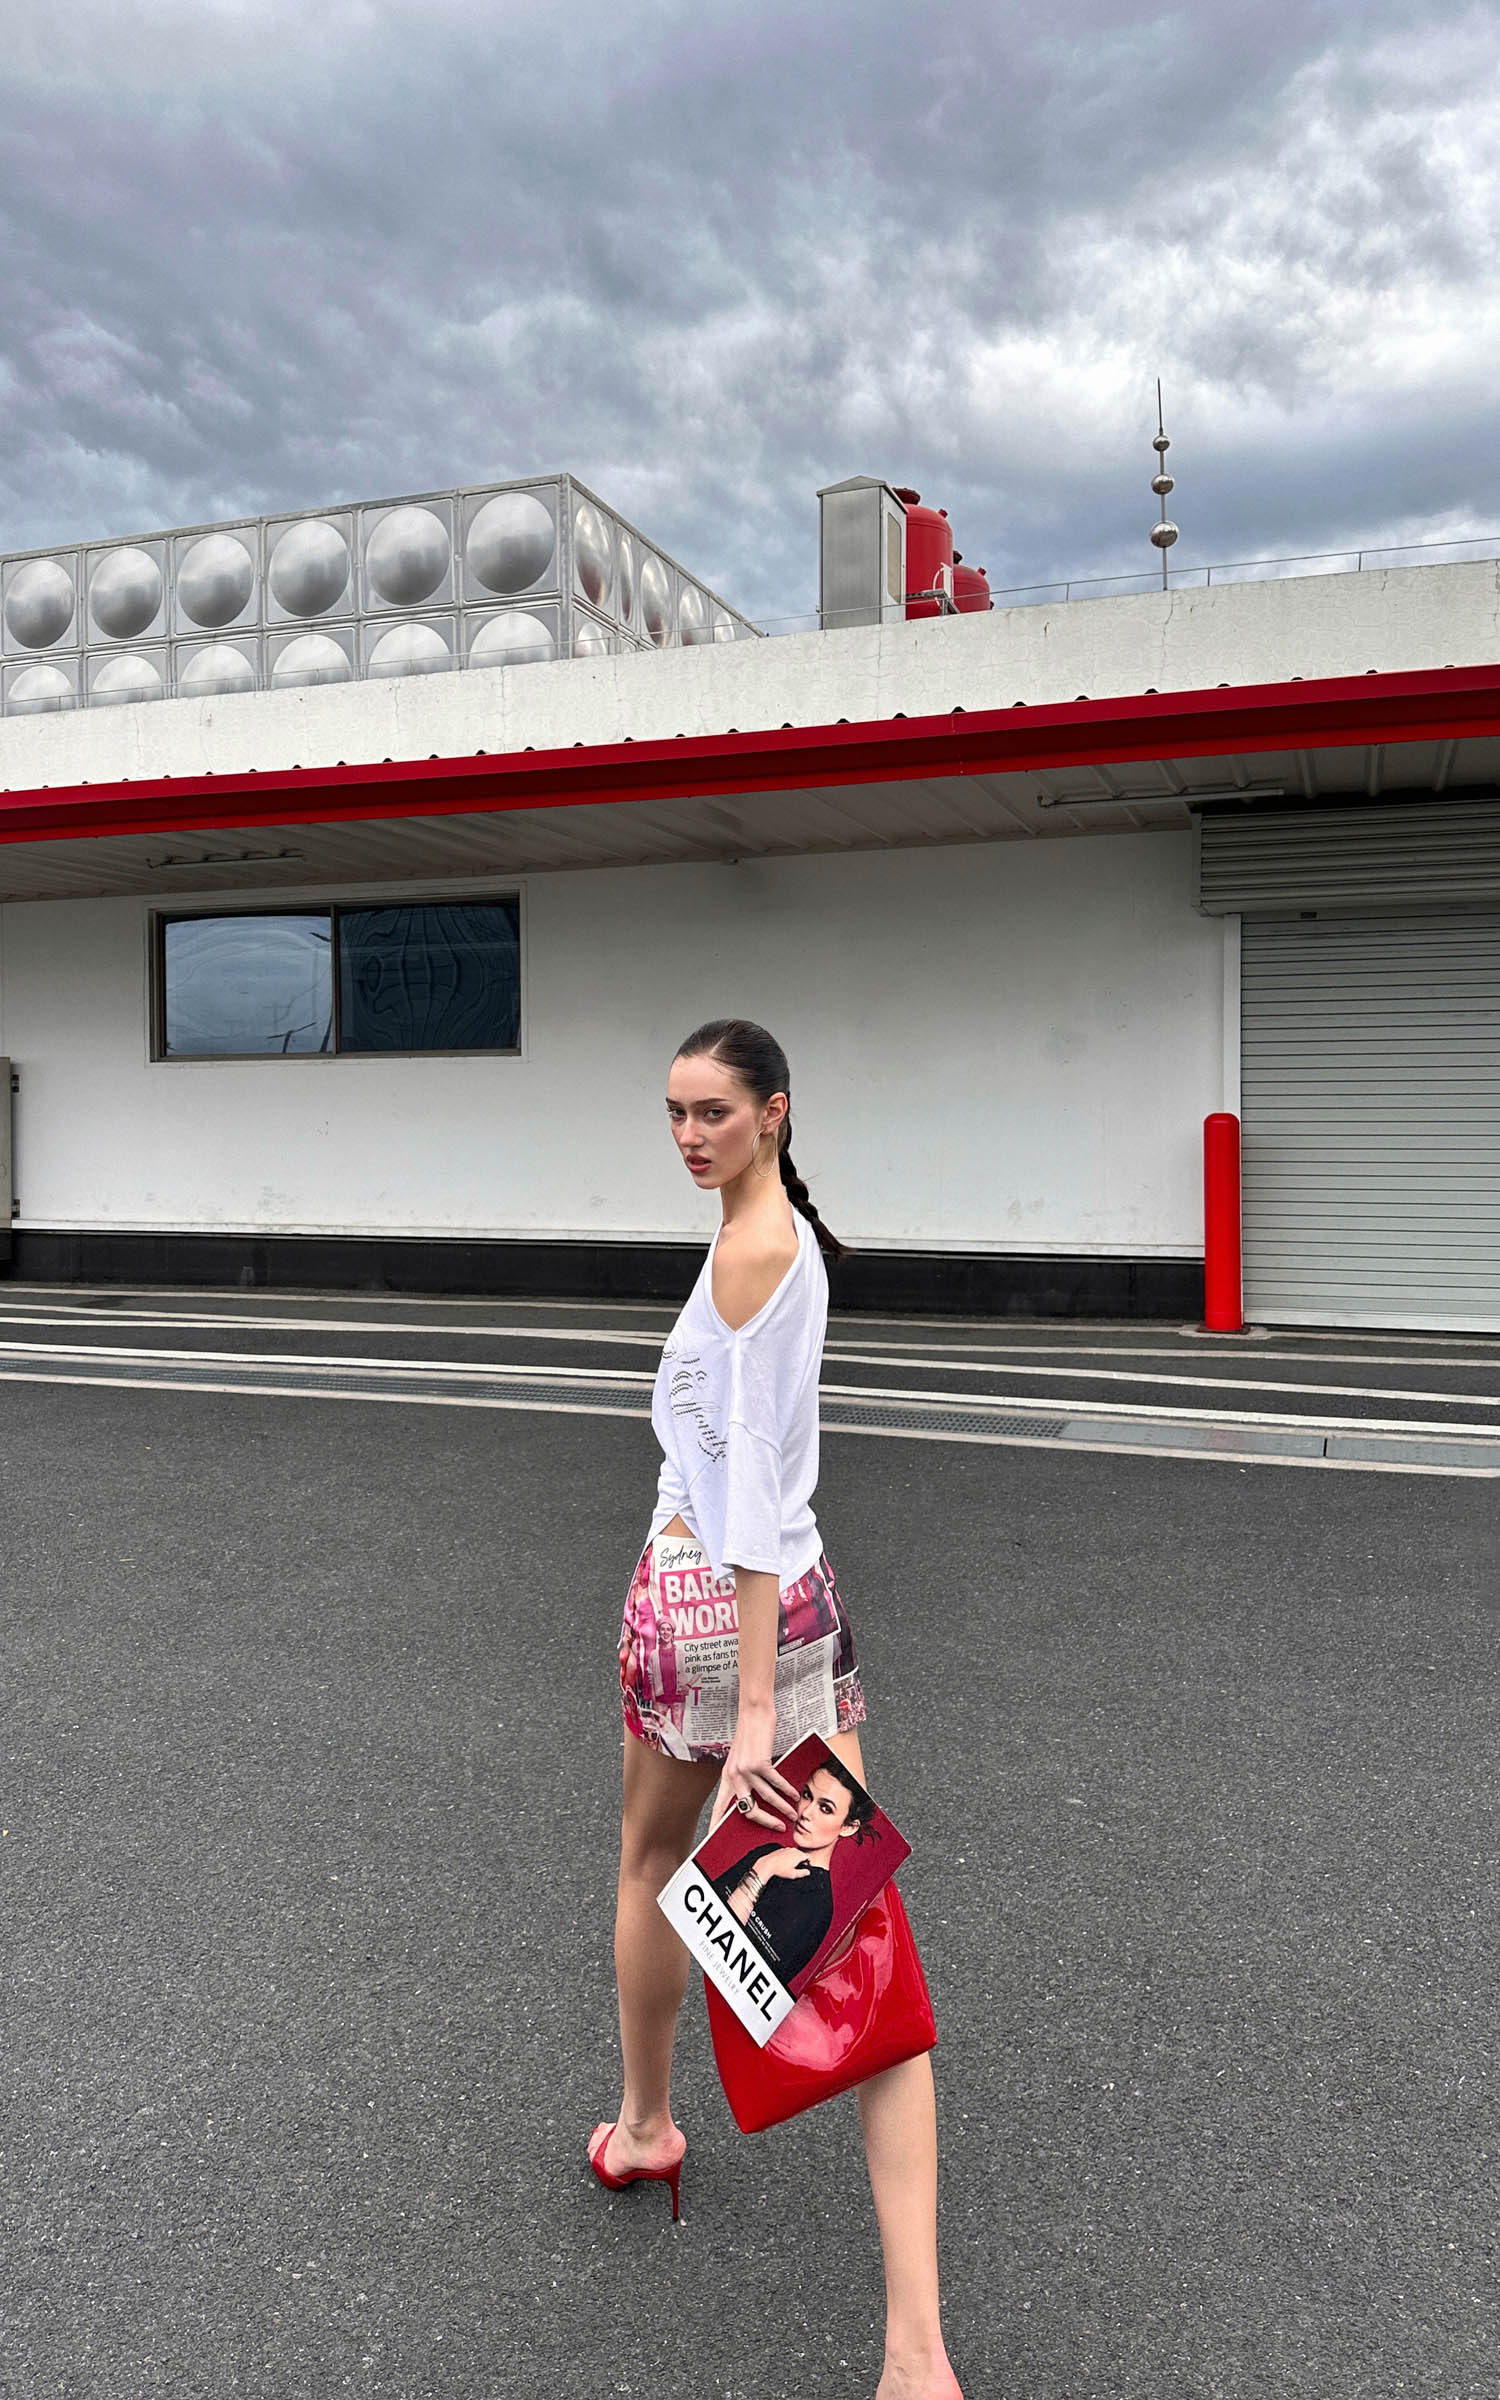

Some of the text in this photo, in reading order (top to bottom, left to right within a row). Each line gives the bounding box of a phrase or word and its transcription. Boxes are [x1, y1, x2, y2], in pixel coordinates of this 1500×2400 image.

[660, 1545, 702, 1568] Sydney
[684, 1642, 699, 1653] City
[700, 1640, 722, 1651] street
[684, 1653, 702, 1664] pink
[702, 1653, 712, 1662] as
[713, 1651, 730, 1661] fans
[685, 1666, 691, 1674] a
[691, 1663, 722, 1675] glimpse
[722, 1660, 731, 1671] of
[754, 1916, 773, 1940] CRUSH
[684, 1884, 780, 2022] CHANEL
